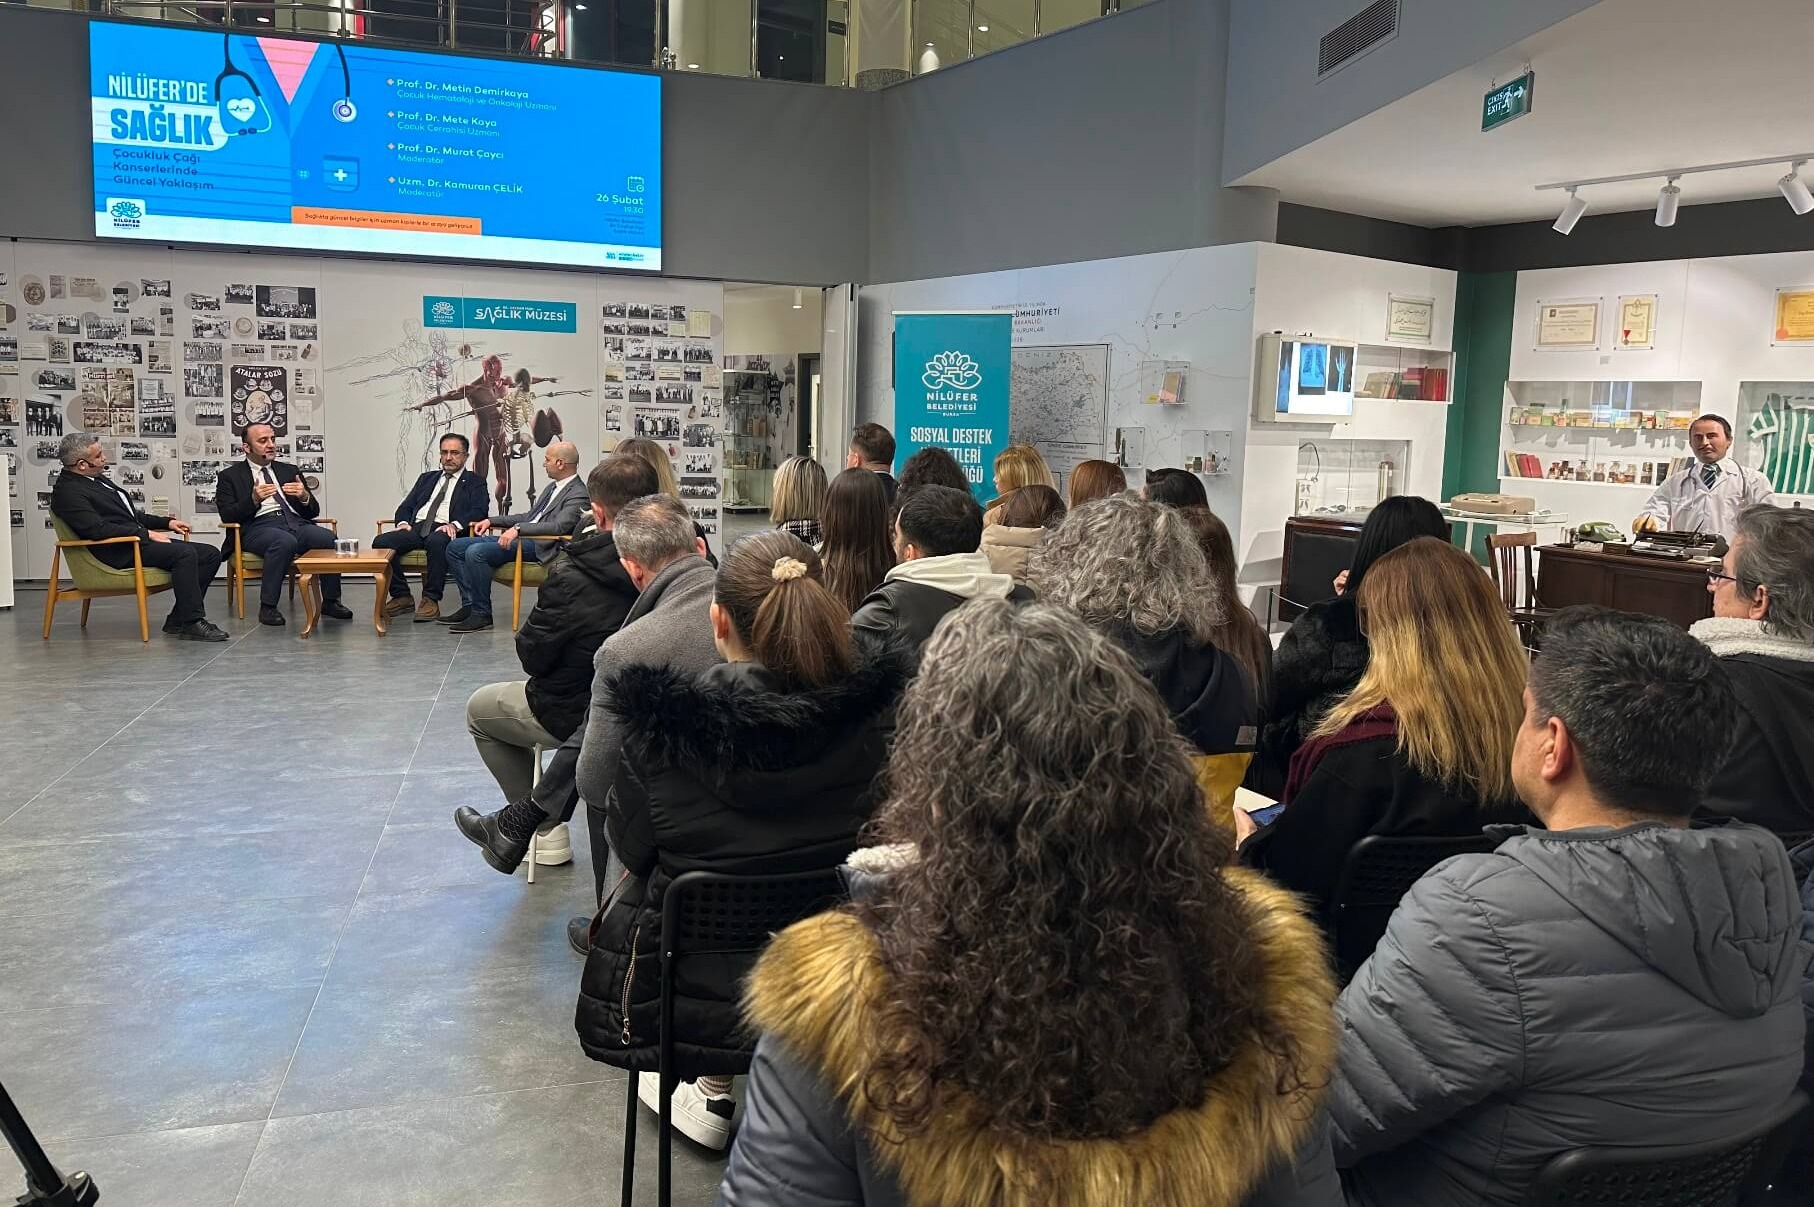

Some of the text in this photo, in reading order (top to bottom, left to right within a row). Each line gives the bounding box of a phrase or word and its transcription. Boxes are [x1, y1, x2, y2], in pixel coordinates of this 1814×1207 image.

[108, 72, 208, 103] NİLÜFER'DE
[397, 79, 529, 99] Prof. Dr. Metin Demirkaya
[1488, 101, 1501, 116] EXIT
[110, 103, 215, 146] SAĞLIK
[397, 111, 497, 128] Prof. Dr. Mete Kaya
[112, 148, 200, 165] Çocukluk Çağı
[397, 143, 424, 152] Prof.
[425, 145, 440, 154] Dr.
[442, 146, 475, 157] Murat
[113, 162, 199, 176] Kanserlerinde
[113, 175, 215, 191] Güncel Yaklaşım
[398, 176, 524, 195] Uzm. Dr. Kamuran ÇELİK
[596, 193, 644, 206] 26 Şubat
[474, 305, 567, 325] SAĞLIK MÜZESİ
[1013, 306, 1061, 318] UMHURİYETİ
[235, 367, 262, 379] ATALAR
[926, 390, 978, 401] NİLÜFER
[926, 402, 977, 411] BELEDİYESİ
[910, 426, 993, 445] SOSYAL DESTEK
